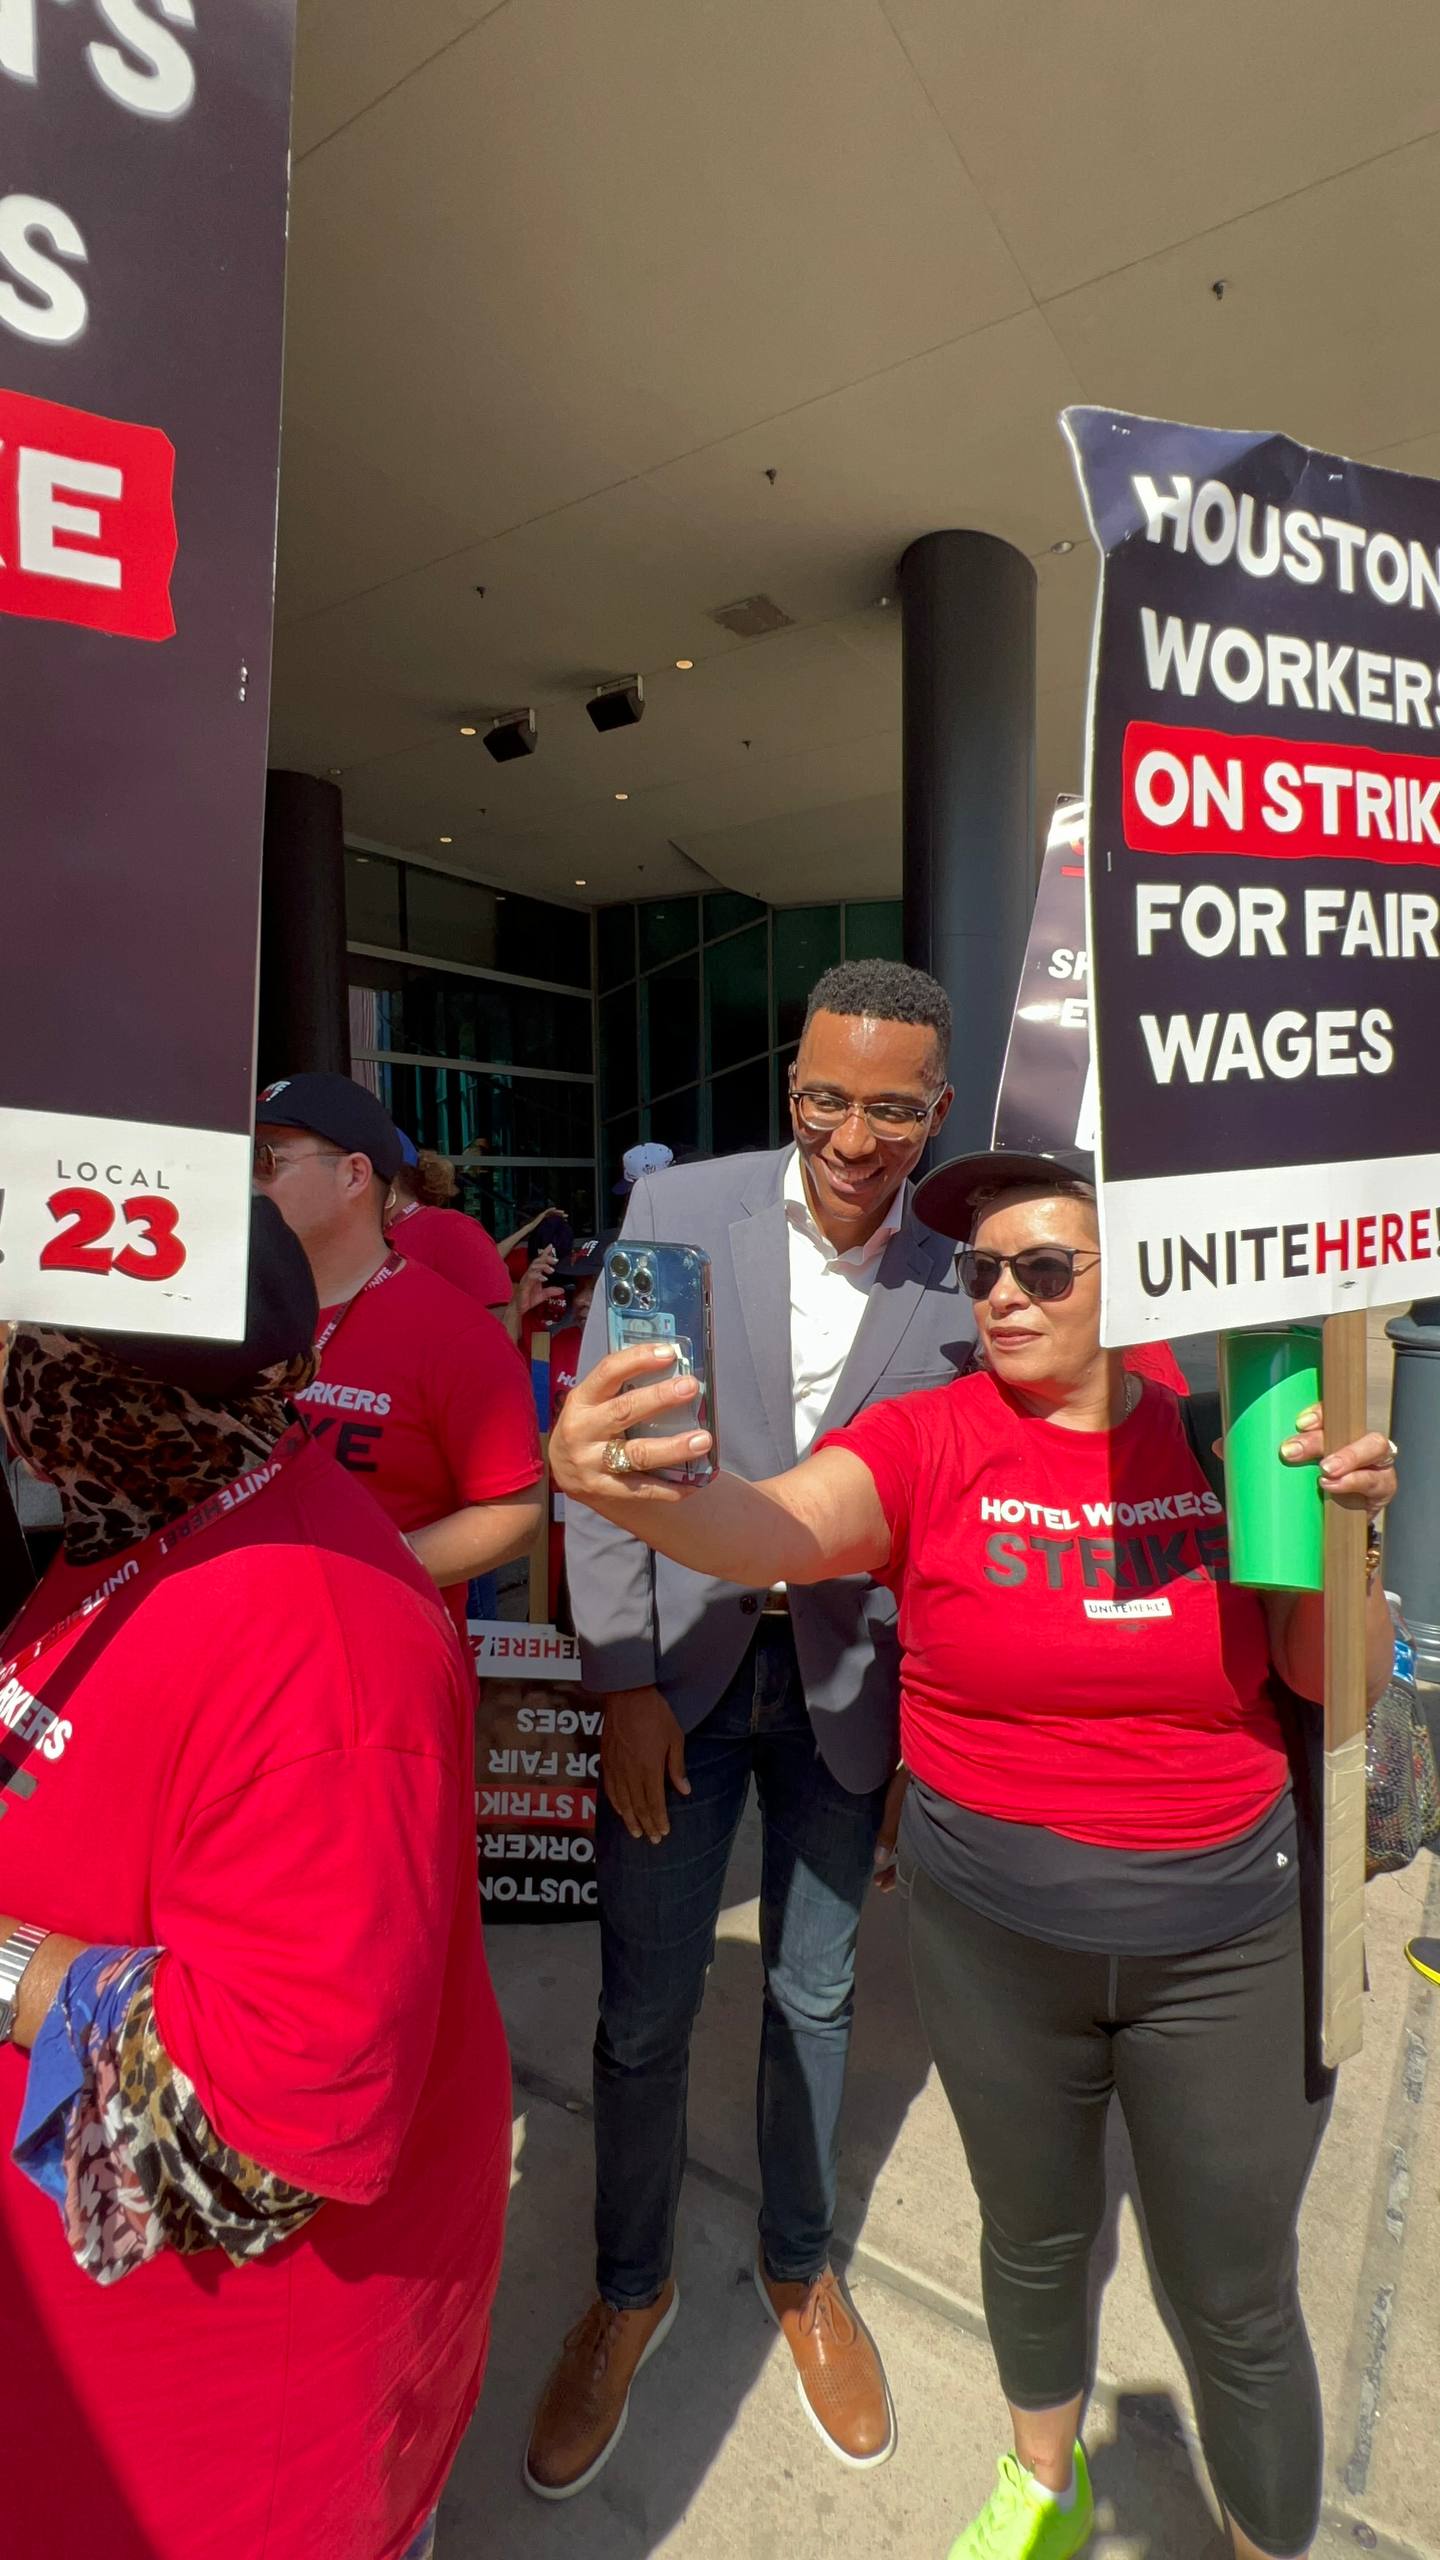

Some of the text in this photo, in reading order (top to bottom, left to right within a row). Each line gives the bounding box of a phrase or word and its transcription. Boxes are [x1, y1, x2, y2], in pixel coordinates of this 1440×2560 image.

[1131, 475, 1440, 616] HOUSTON
[1140, 606, 1440, 728] WORKER
[1134, 750, 1440, 846] ON STRIK
[1136, 883, 1439, 958] FOR FAIR
[1139, 1008, 1394, 1084] WAGES
[57, 1159, 170, 1190] LOCAL
[39, 1186, 187, 1281] 23
[294, 1381, 392, 1415] RKERS
[980, 1496, 1080, 1530] HOTEL
[983, 1525, 1231, 1589] STRIKE
[0, 1677, 73, 1760] RKERS
[516, 1708, 605, 1736] AGES
[488, 1749, 559, 1776] FAIR
[474, 1791, 575, 1818] STRIK
[476, 1833, 597, 1863] ORKER
[477, 1876, 598, 1904] OUSTON
